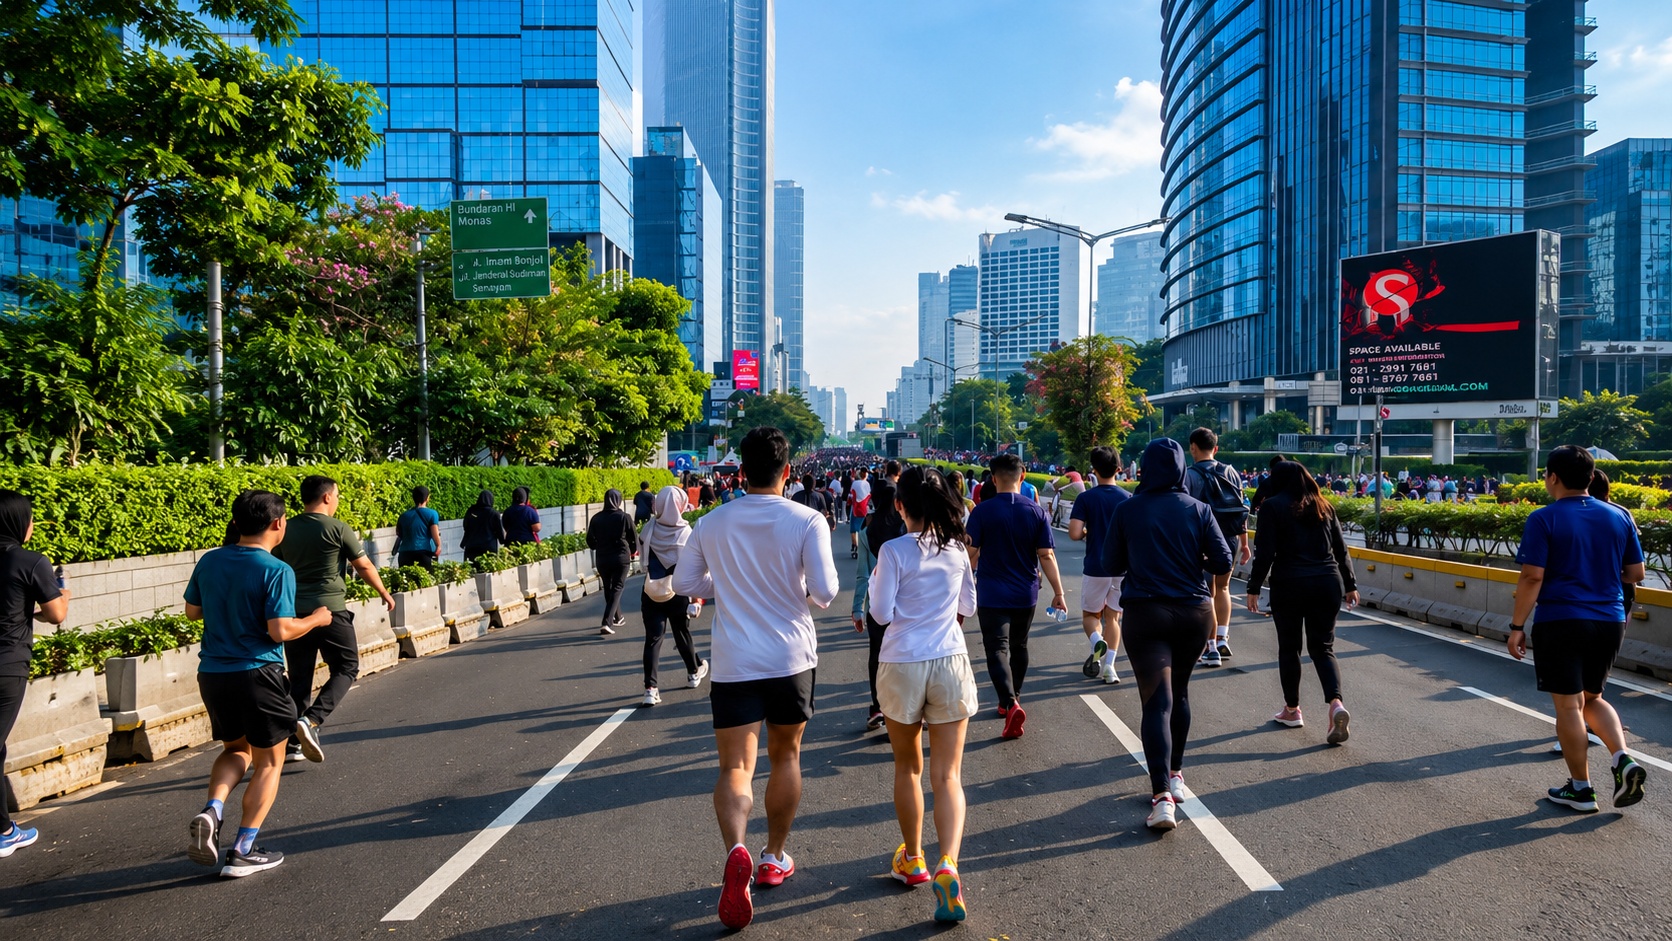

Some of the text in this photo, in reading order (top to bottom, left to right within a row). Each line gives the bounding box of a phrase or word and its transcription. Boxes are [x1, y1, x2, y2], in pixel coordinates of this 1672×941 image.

[457, 203, 516, 214] Bundaran HI
[458, 217, 492, 226] Monas
[514, 255, 544, 267] Bonjol
[1349, 342, 1441, 355] SPACE AVAILABLE
[1350, 366, 1368, 375] 021
[1379, 364, 1405, 373] 2991
[1382, 374, 1408, 383] 8767
